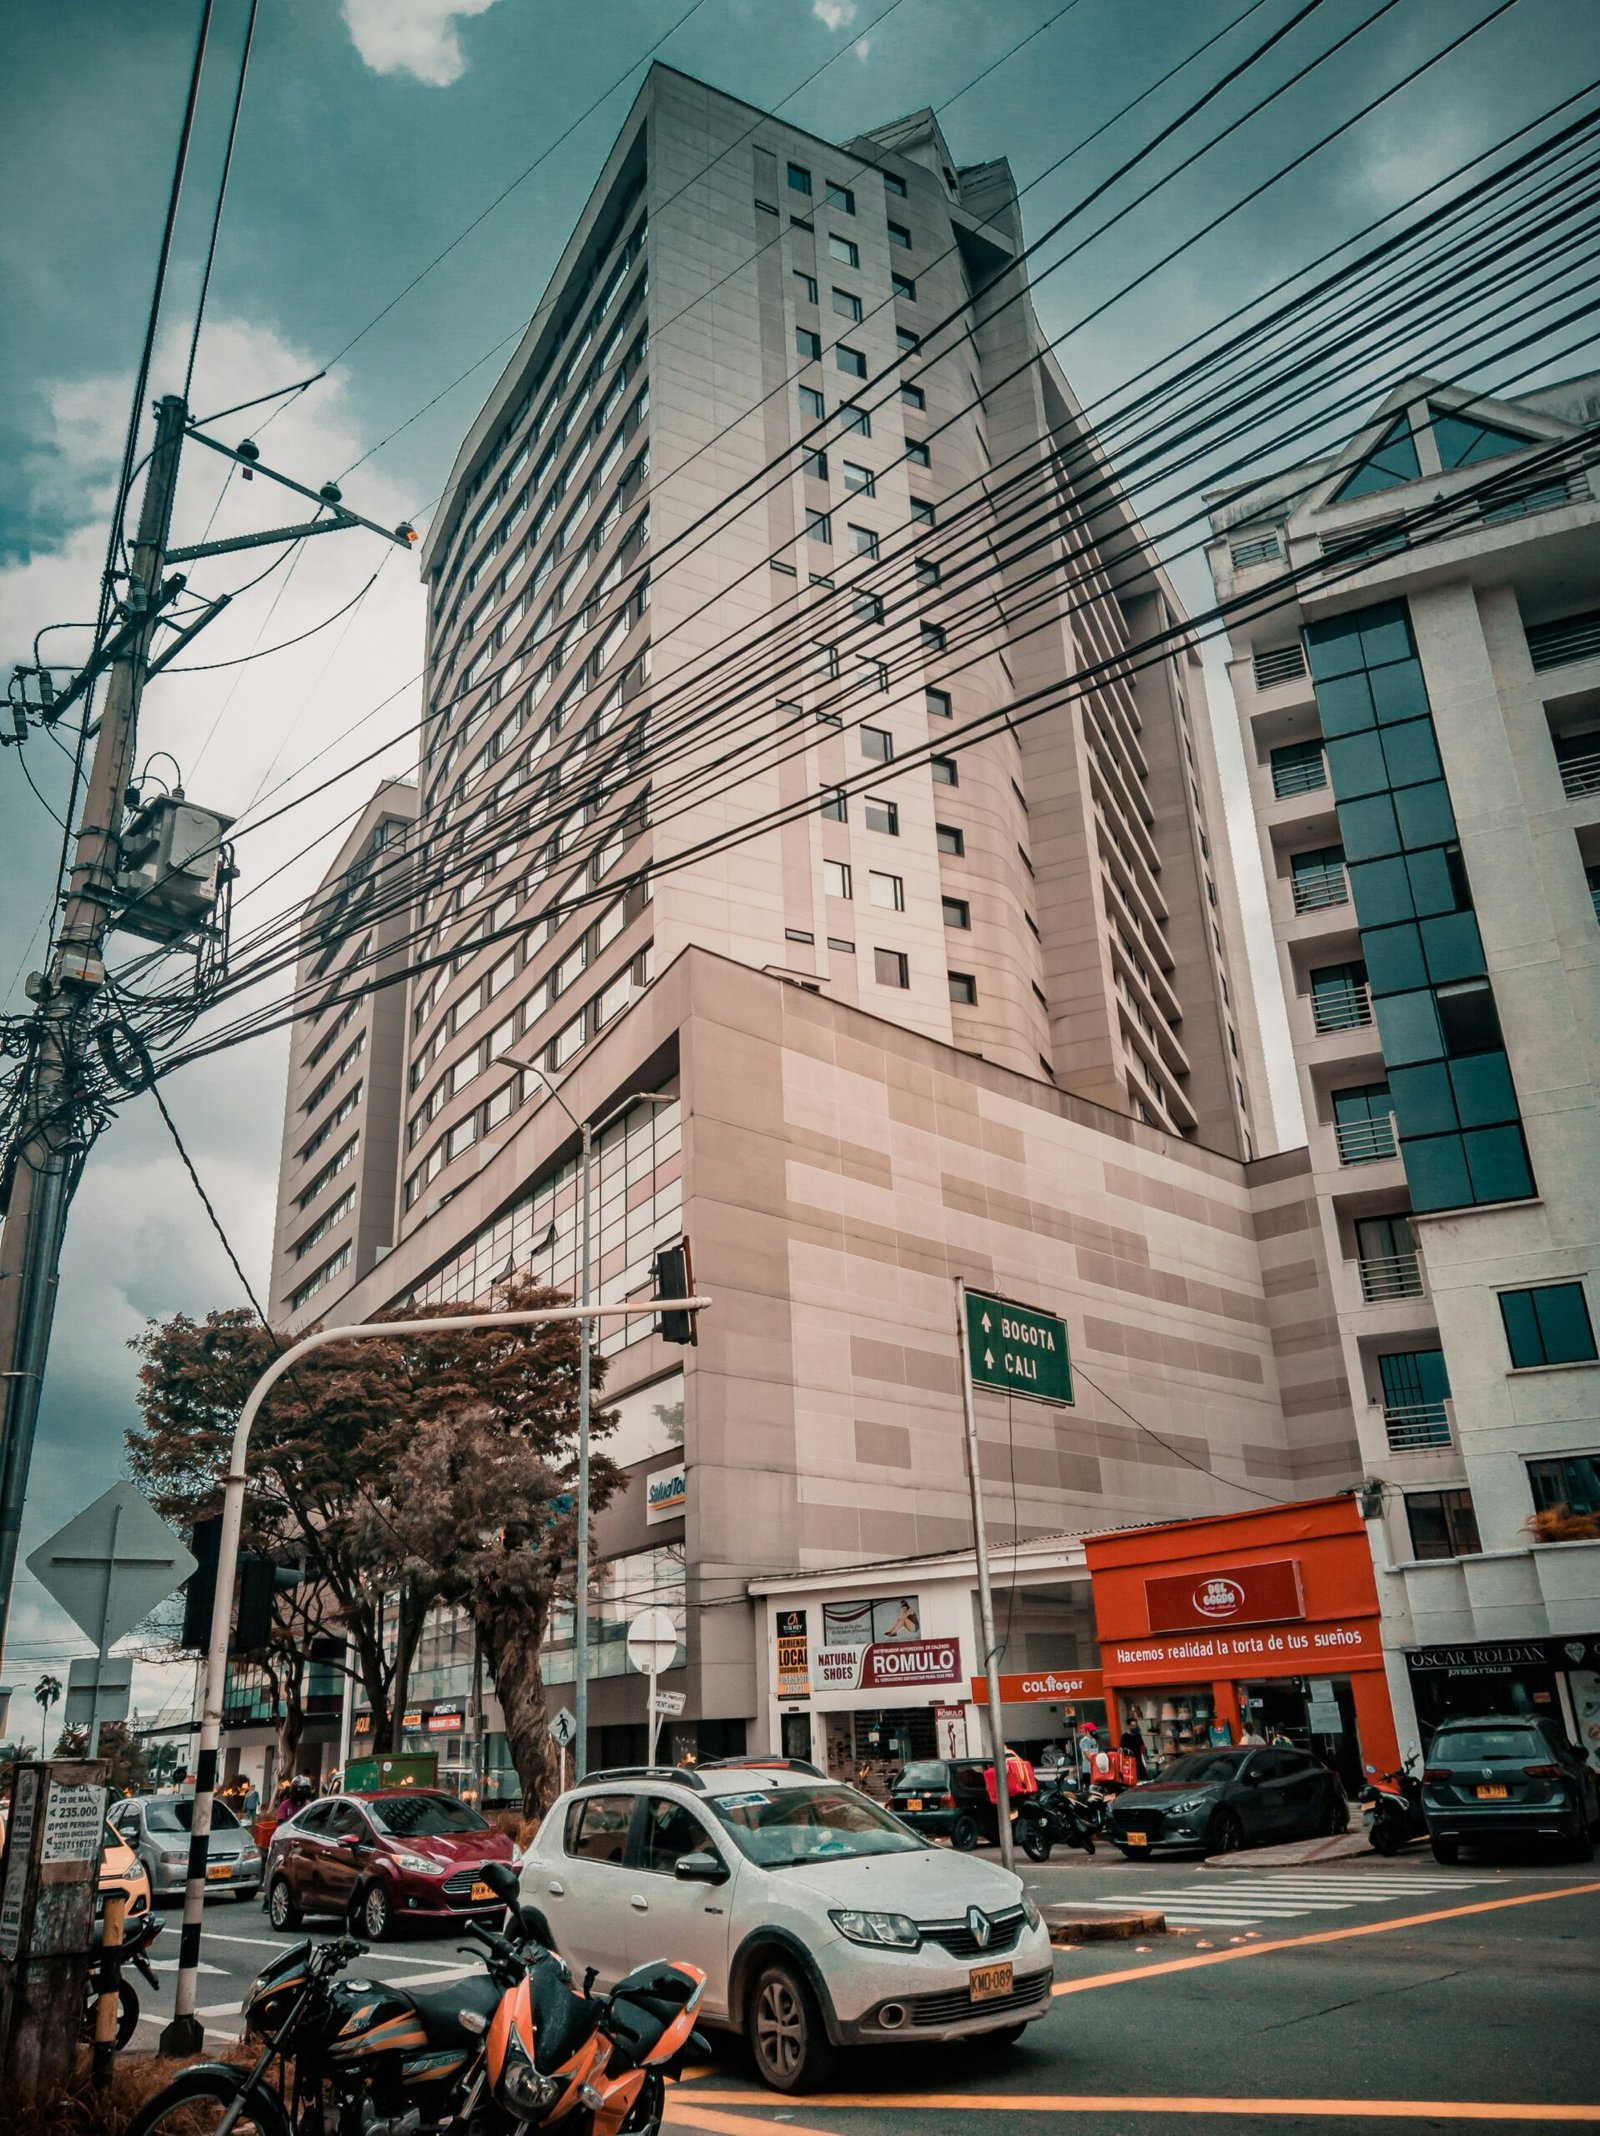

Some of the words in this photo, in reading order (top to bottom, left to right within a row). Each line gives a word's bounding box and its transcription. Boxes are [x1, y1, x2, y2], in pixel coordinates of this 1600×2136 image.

[1002, 1318, 1055, 1351] BOGOTA
[1005, 1353, 1037, 1379] CALI
[1117, 1646, 1164, 1664] Hacemos
[1168, 1642, 1214, 1659] realidad
[1217, 1640, 1229, 1655] la
[1233, 1637, 1264, 1653] torta
[1268, 1634, 1284, 1651] de
[1287, 1634, 1309, 1649] tus
[1314, 1629, 1362, 1648] sueños
[818, 1652, 857, 1667] NATURAL
[873, 1650, 954, 1674] ROMULO
[1411, 1651, 1466, 1667] OSCAR
[823, 1666, 853, 1681] SHOES
[1485, 1666, 1512, 1674] TALLER
[68, 1796, 77, 1804] DE
[59, 1806, 98, 1818] 235.000
[54, 1822, 68, 1830] POR
[69, 1820, 99, 1829] PERSONA
